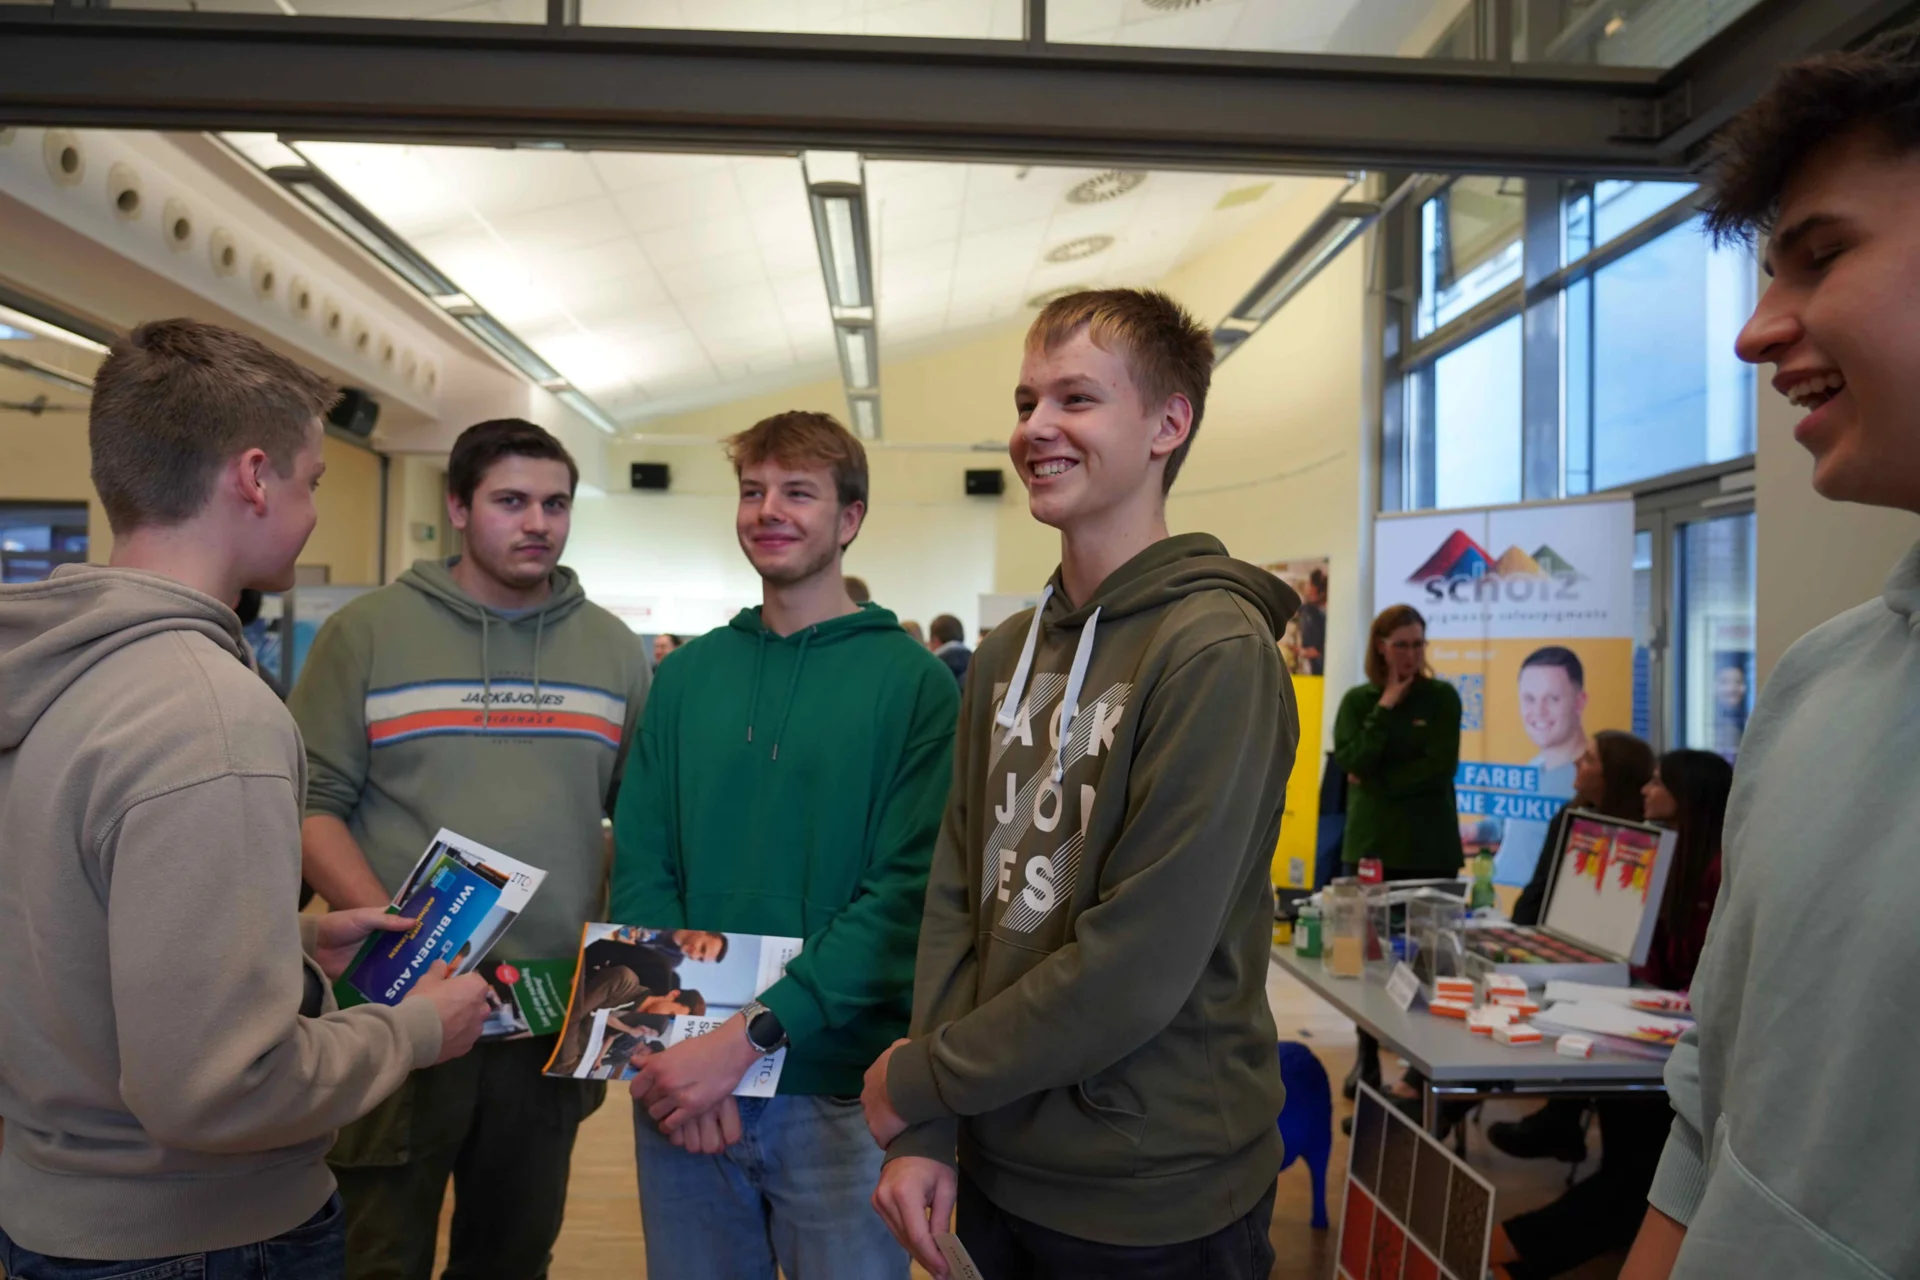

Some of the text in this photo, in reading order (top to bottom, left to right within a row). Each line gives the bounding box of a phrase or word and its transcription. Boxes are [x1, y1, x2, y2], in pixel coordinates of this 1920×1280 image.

[1425, 558, 1579, 604] scholz
[1464, 765, 1537, 790] FARBE
[448, 885, 476, 914] WIR
[411, 915, 453, 968] BILDEN
[385, 967, 412, 999] AUS
